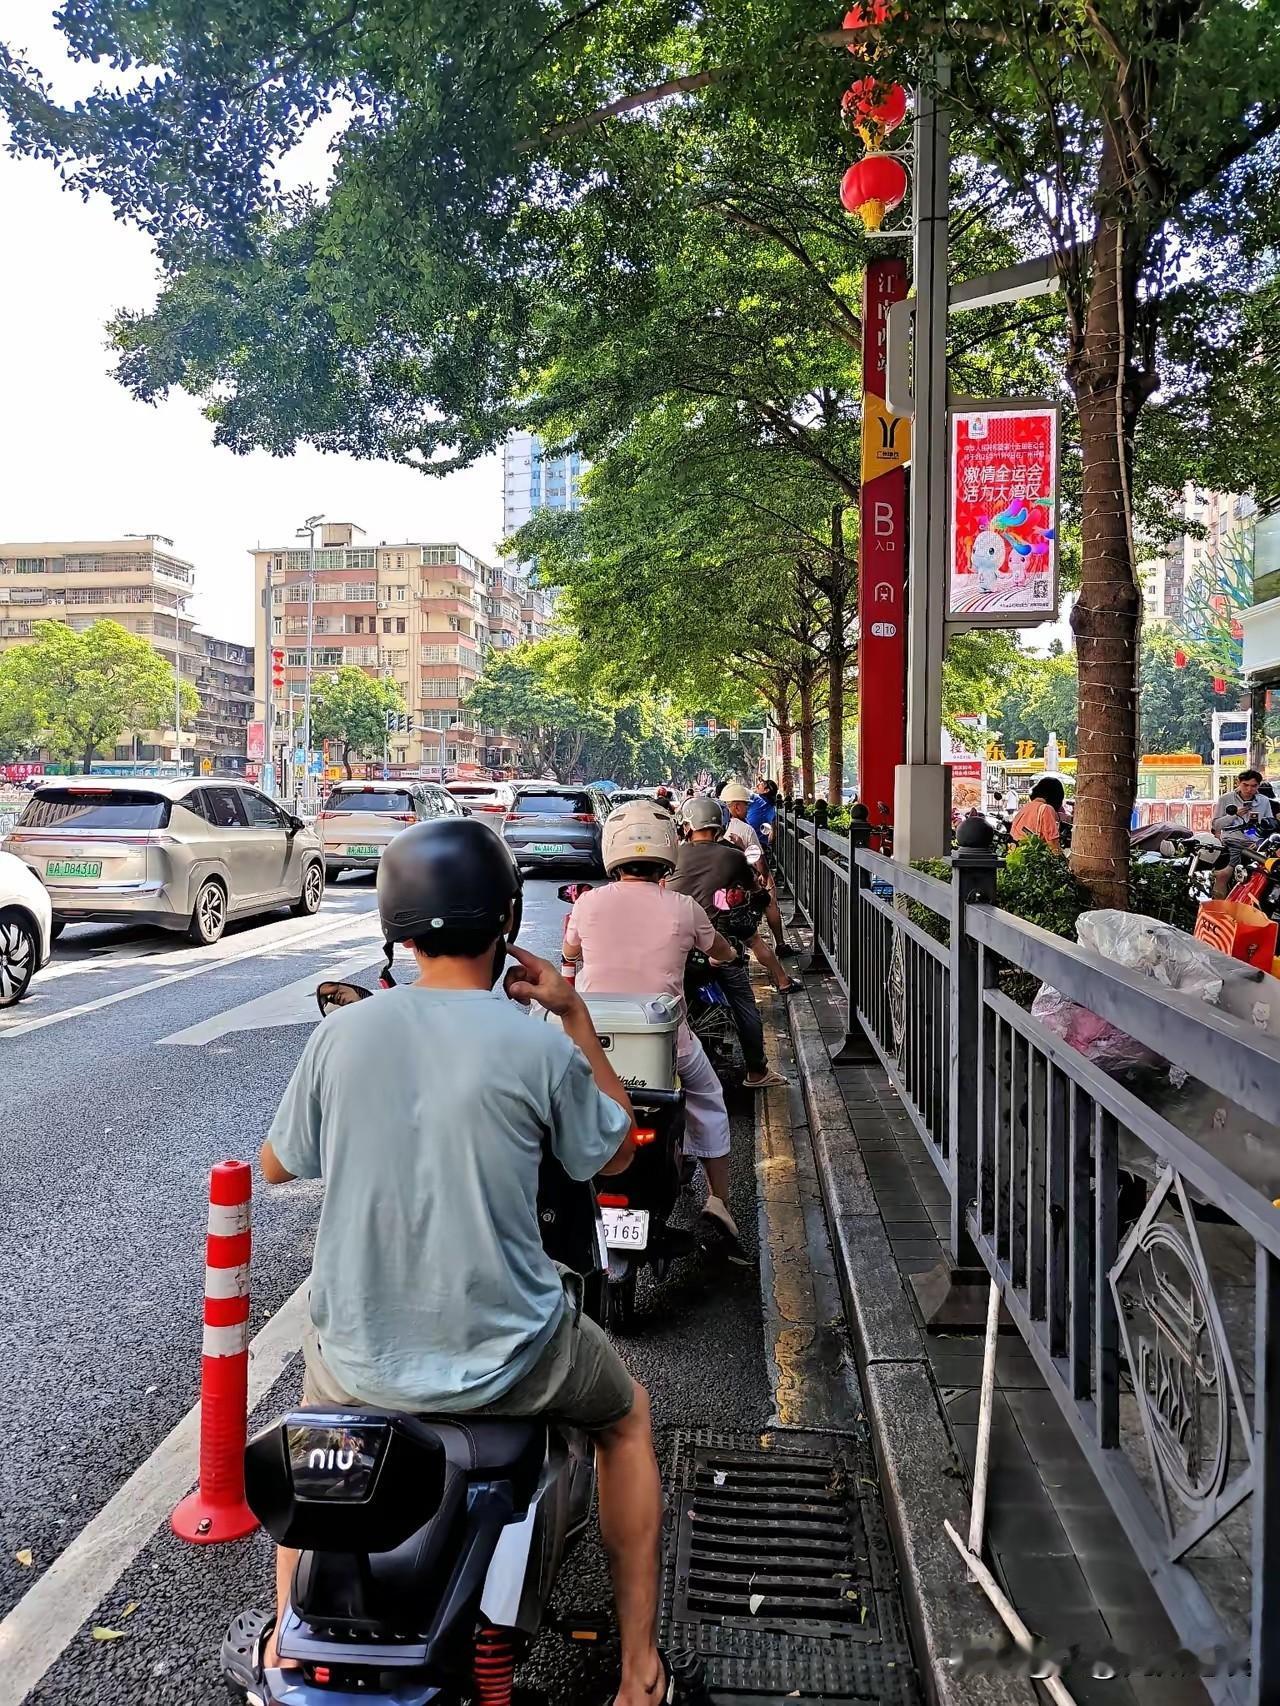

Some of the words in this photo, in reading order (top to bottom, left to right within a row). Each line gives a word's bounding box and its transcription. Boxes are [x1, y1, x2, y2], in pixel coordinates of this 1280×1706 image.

[963, 463, 1044, 483] 激情全运会
[963, 483, 1041, 502] 活力大湾区
[875, 502, 894, 536] B
[875, 540, 895, 551] 入口
[875, 625, 881, 634] 2
[886, 626, 895, 635] 10
